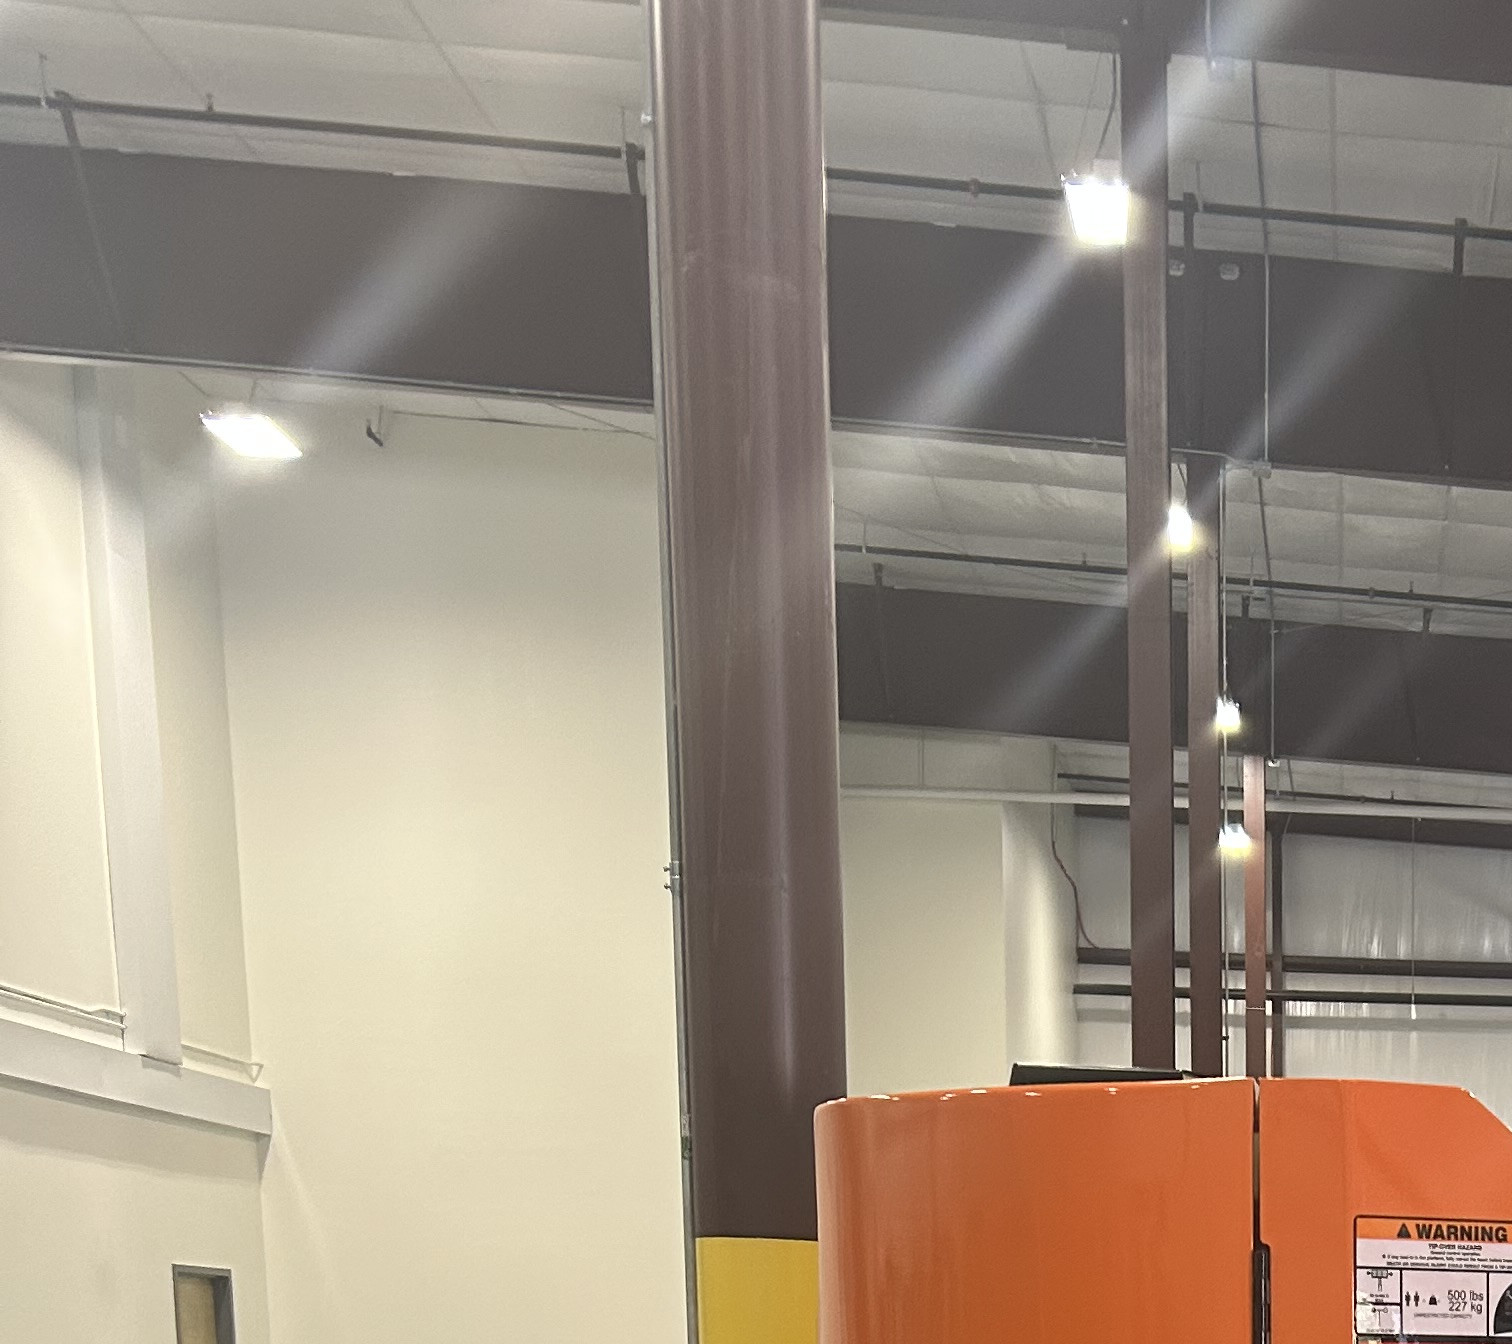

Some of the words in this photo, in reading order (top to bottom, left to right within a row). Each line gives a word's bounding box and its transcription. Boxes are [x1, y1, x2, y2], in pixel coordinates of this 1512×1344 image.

[1415, 1223, 1509, 1243] WARNING
[1447, 1290, 1466, 1300] 500
[1469, 1290, 1483, 1301] lbs
[1448, 1301, 1467, 1311] 227
[1470, 1301, 1483, 1314] kg
